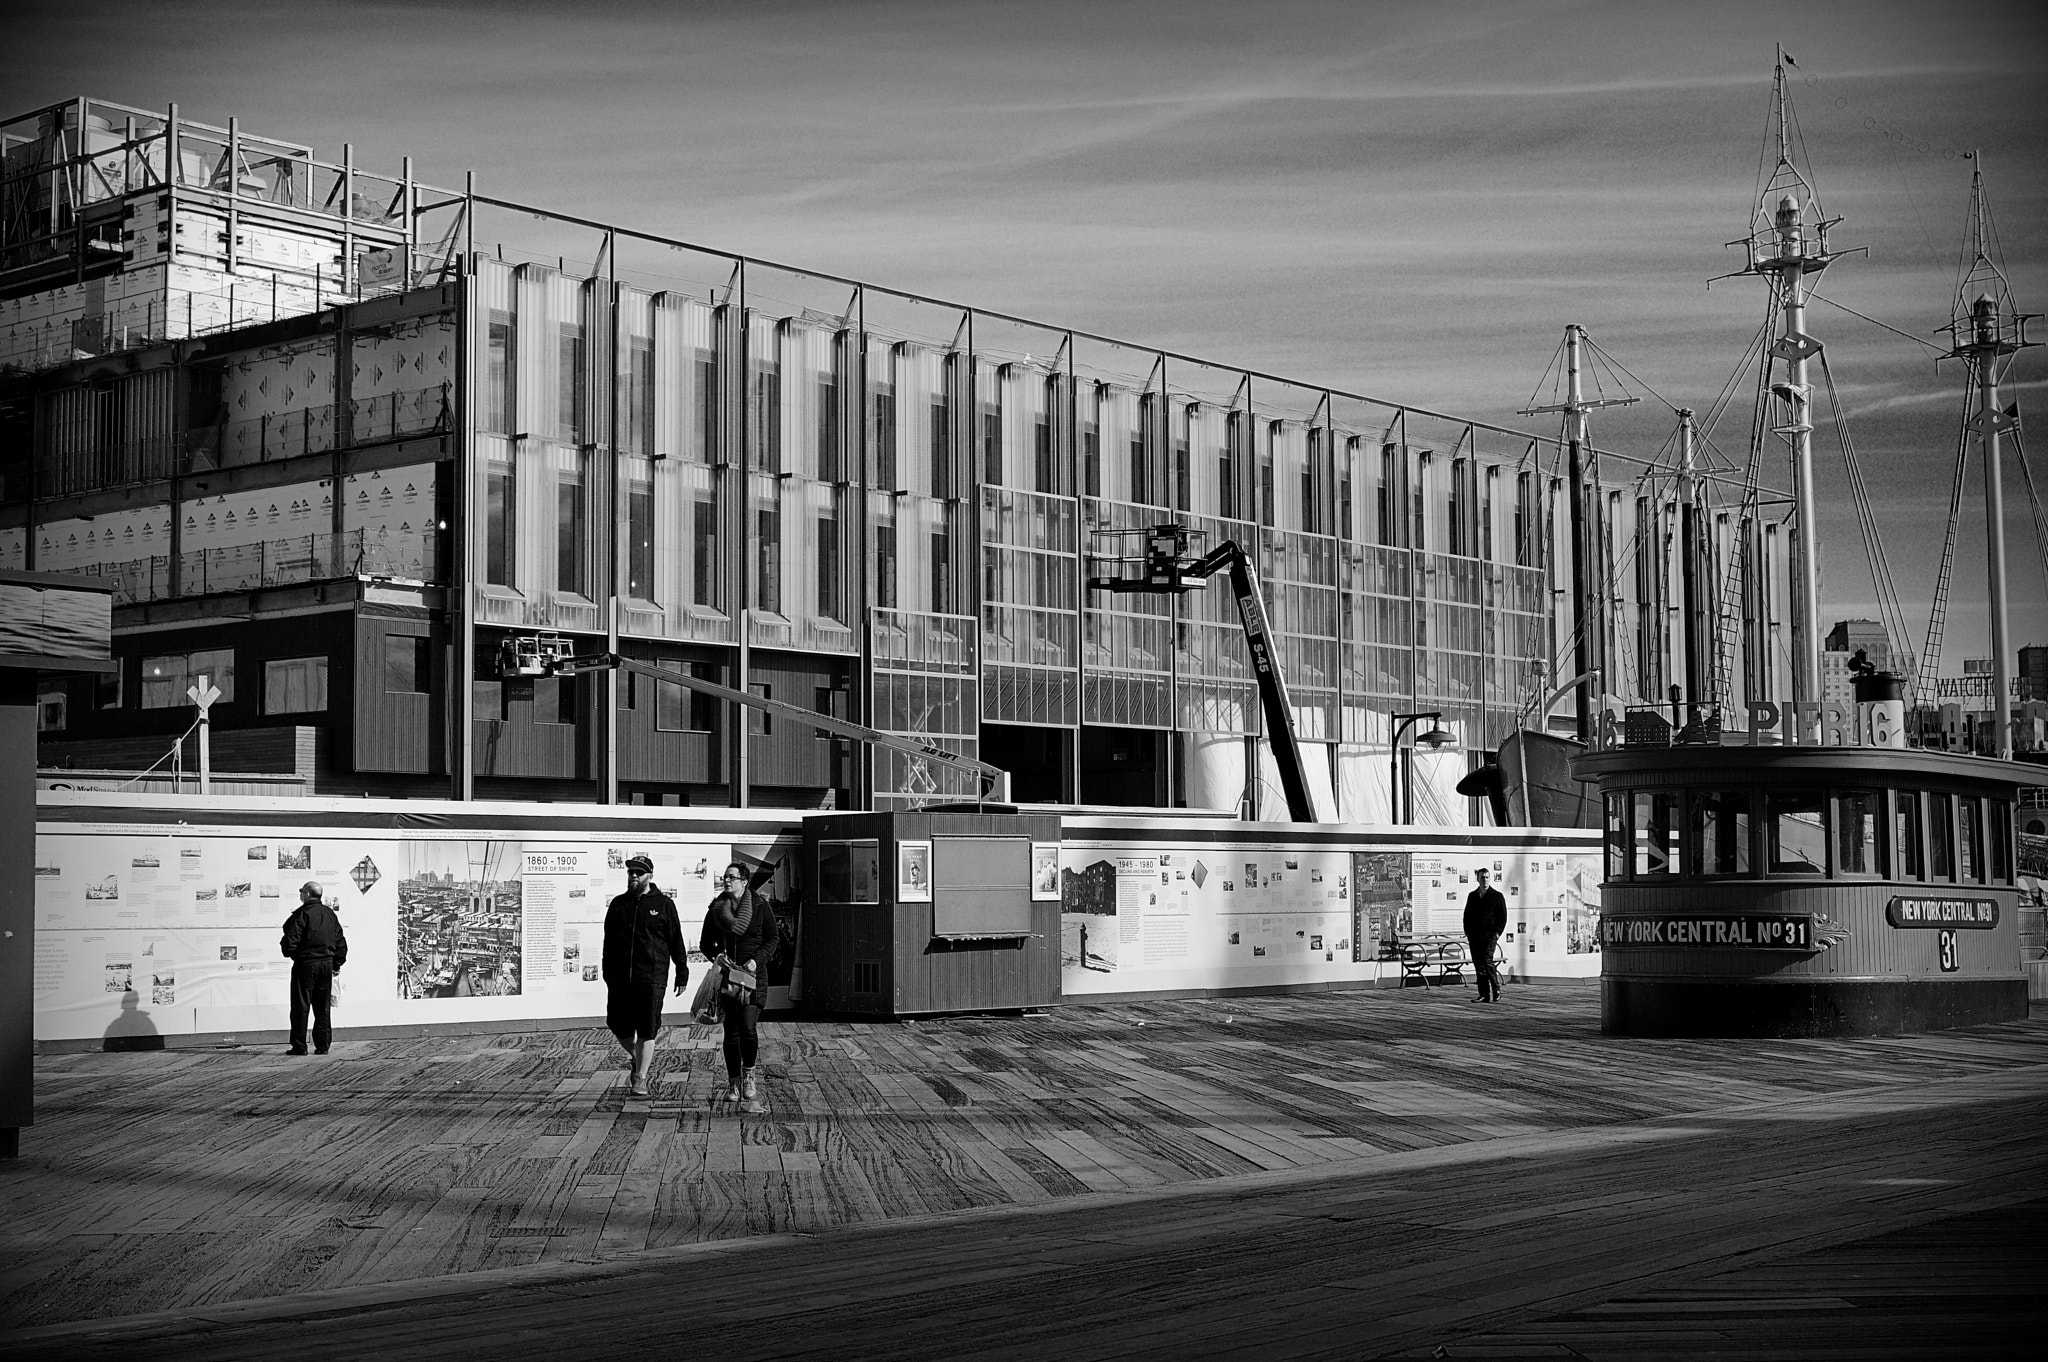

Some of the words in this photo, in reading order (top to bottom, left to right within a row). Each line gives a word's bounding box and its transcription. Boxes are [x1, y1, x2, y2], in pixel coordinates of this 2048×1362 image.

[1243, 599, 1260, 633] ABLE
[1253, 643, 1269, 673] S-45
[1750, 701, 1850, 747] PIER
[1858, 702, 1893, 748] 16
[920, 746, 938, 755] JLG
[938, 750, 959, 761] LIFT
[527, 856, 547, 866] 1860
[557, 856, 578, 866] 1900
[1118, 860, 1133, 869] 1945
[1139, 861, 1154, 869] 1980
[1413, 862, 1426, 870] 1980
[1430, 862, 1442, 870] 2014
[1902, 900, 1920, 920] NEW
[1921, 900, 1941, 921] YORK
[1942, 901, 1975, 921] CENTRAL
[1603, 921, 1624, 942] NEW
[1626, 921, 1664, 943] YORK
[1667, 920, 1753, 943] CENTRAL
[1785, 922, 1805, 945] 31
[1941, 931, 1958, 969] 31
